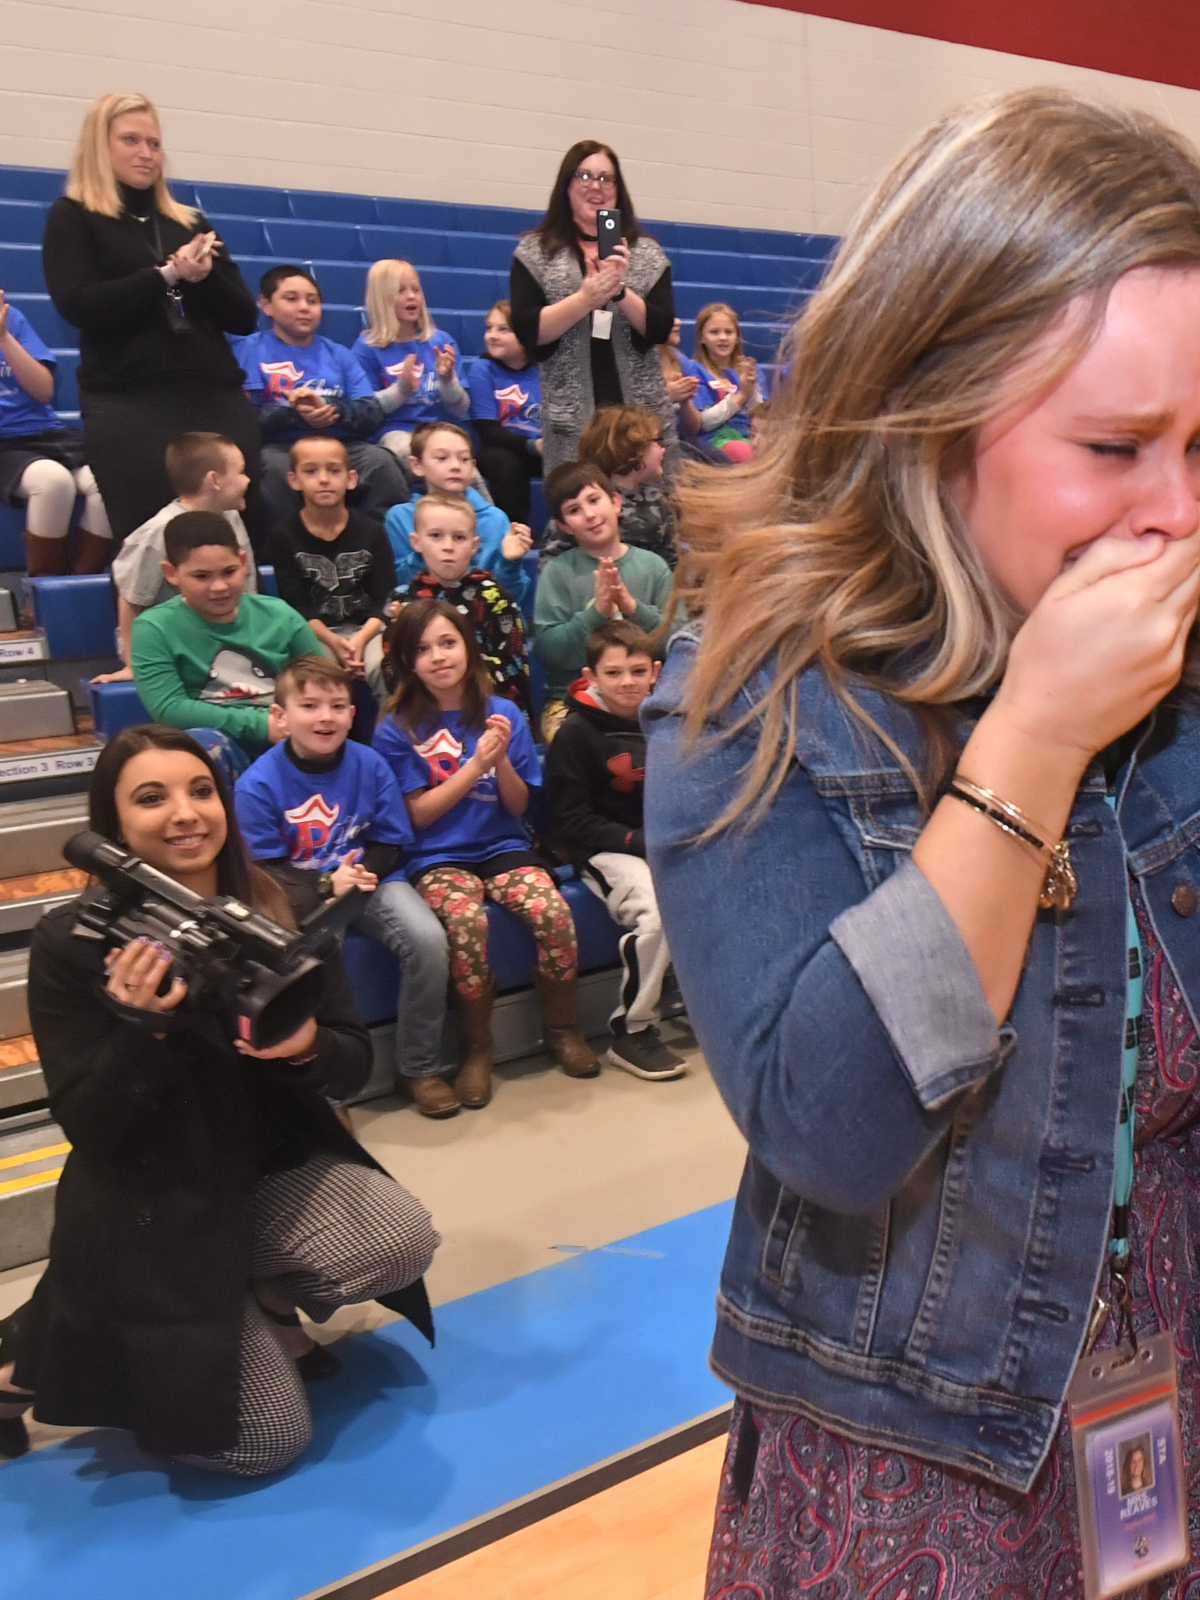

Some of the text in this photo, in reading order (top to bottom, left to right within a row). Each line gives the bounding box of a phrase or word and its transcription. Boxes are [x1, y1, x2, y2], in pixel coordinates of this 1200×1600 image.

[0, 756, 95, 777] ection 3 Row 3
